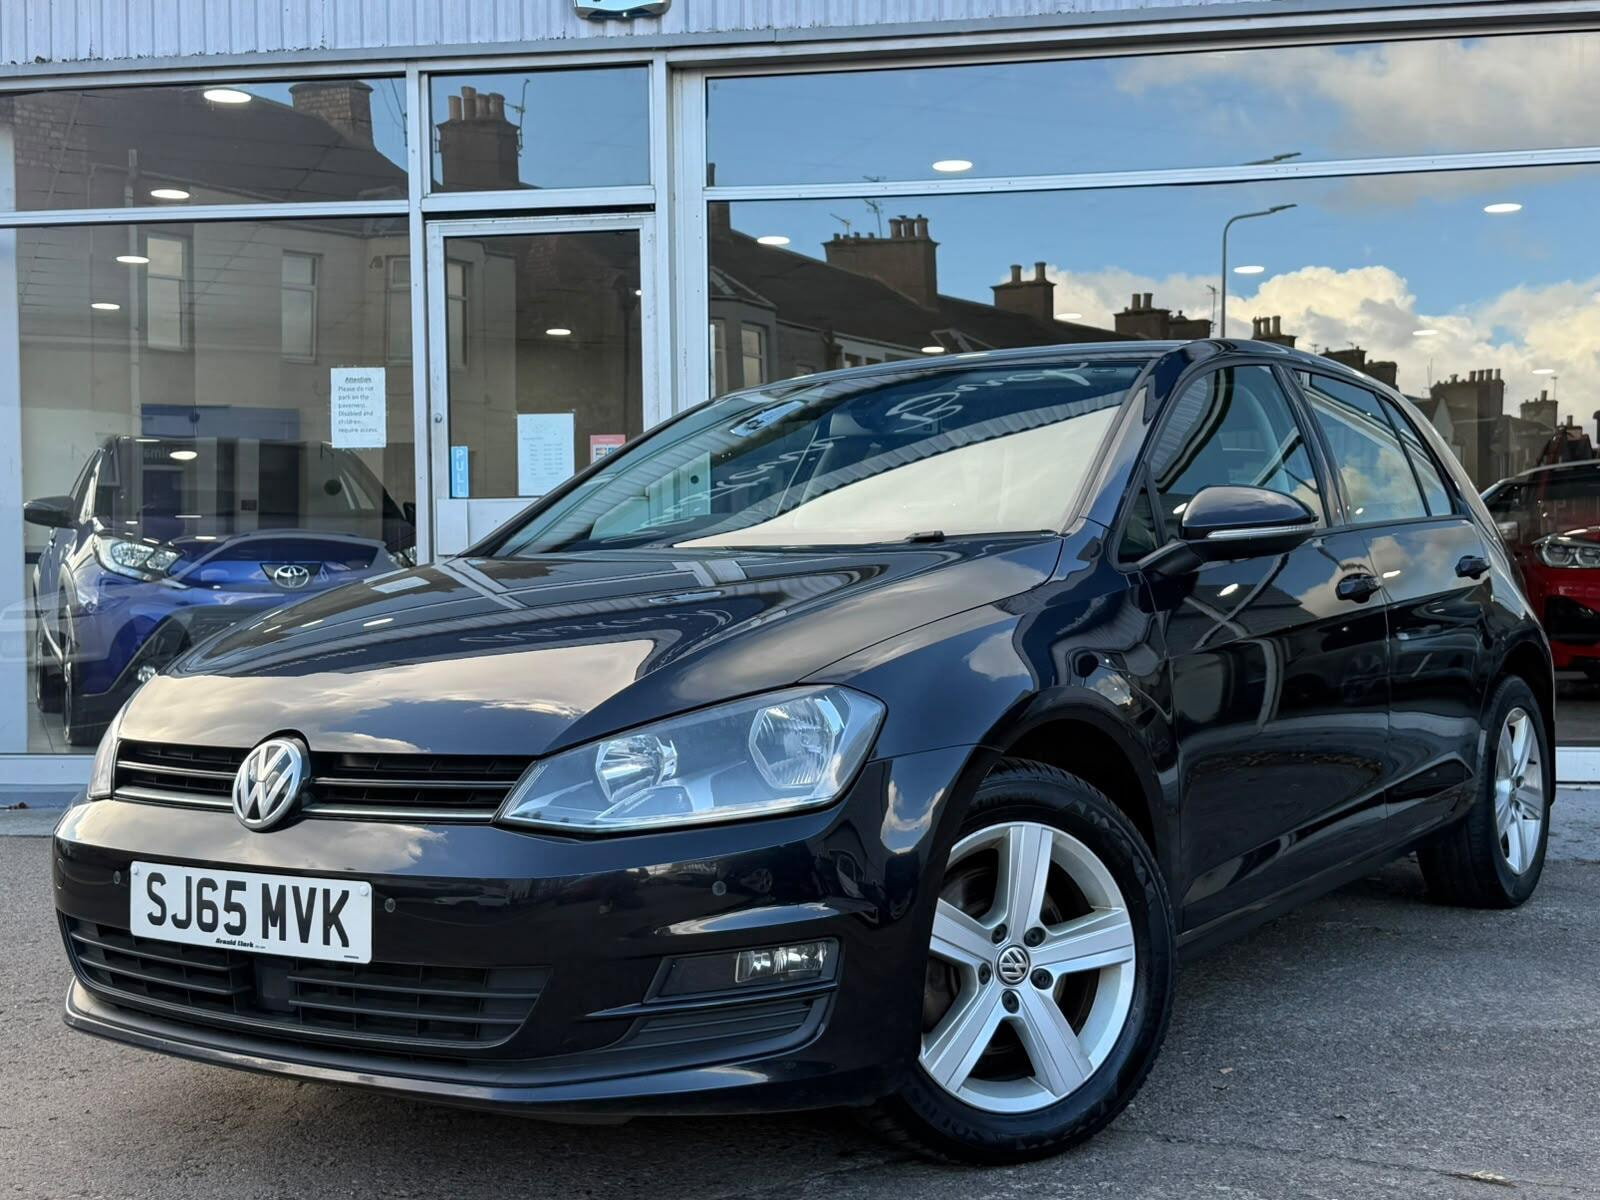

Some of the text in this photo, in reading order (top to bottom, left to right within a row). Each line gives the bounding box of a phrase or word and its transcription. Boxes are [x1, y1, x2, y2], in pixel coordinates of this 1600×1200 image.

[455, 448, 465, 497] PULL
[146, 872, 350, 948] SJ65 MVK
